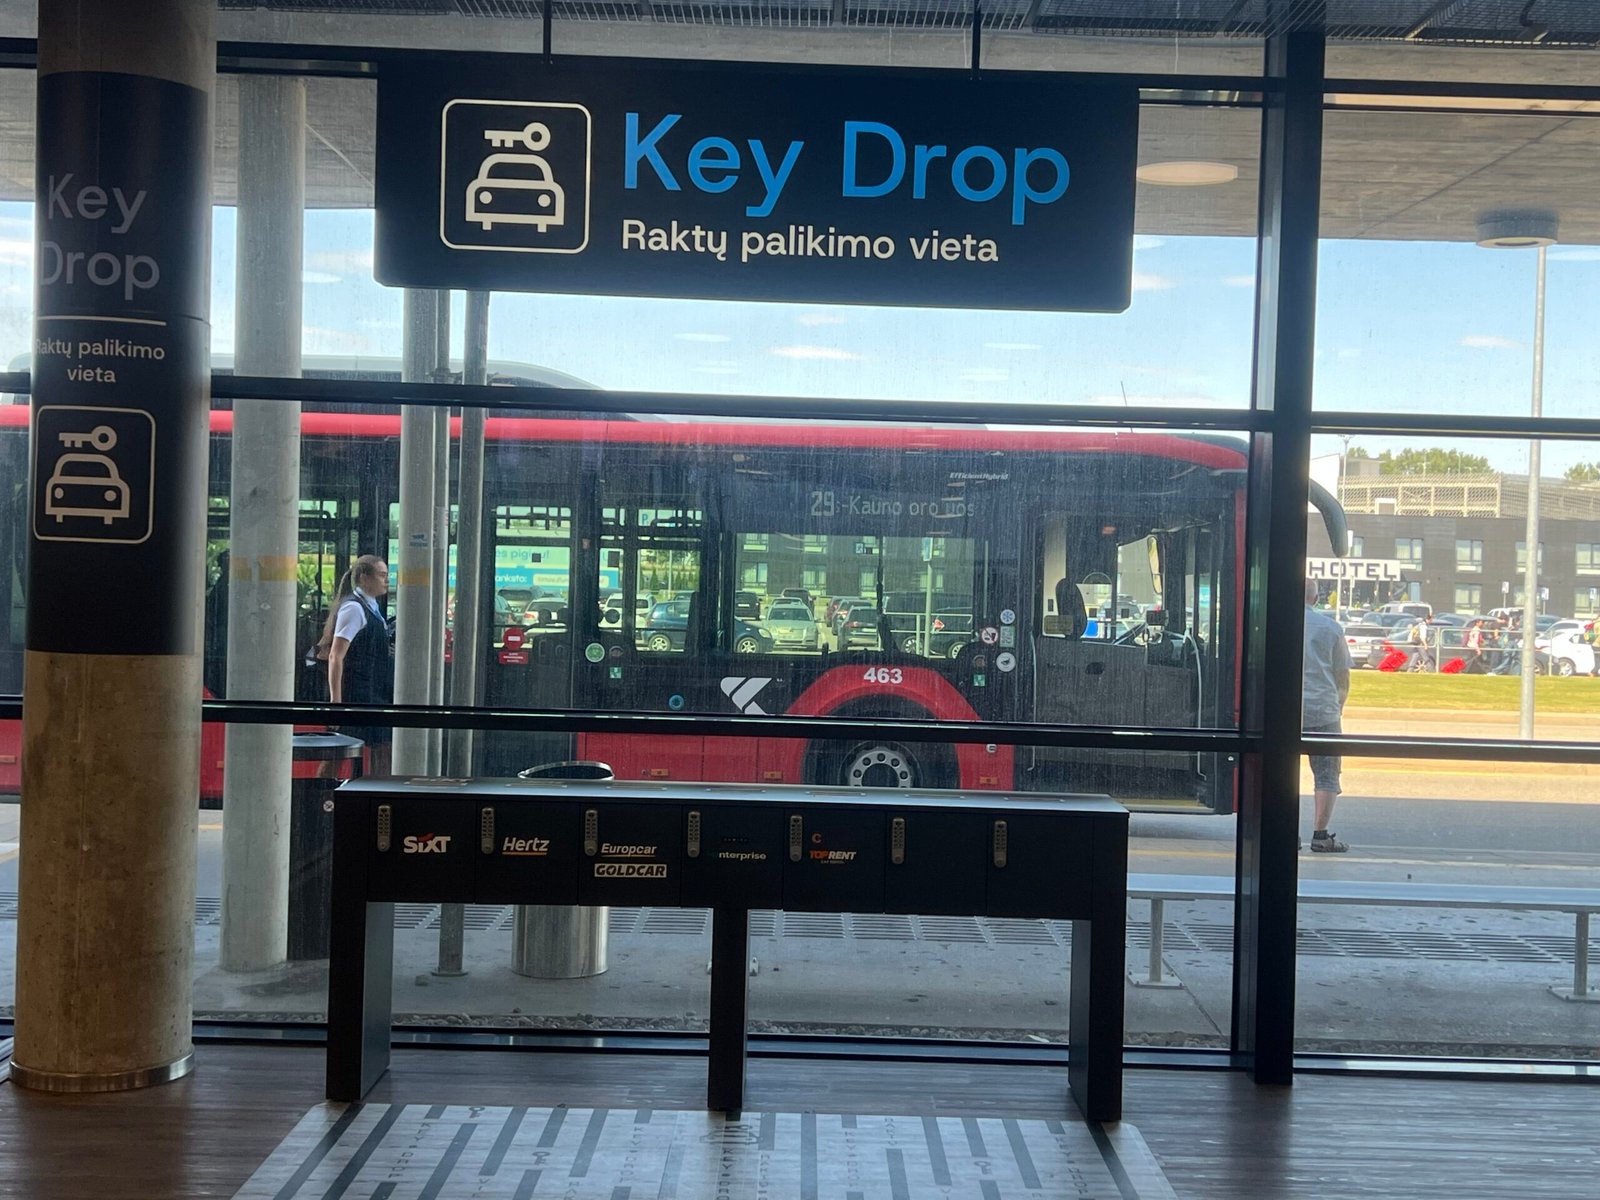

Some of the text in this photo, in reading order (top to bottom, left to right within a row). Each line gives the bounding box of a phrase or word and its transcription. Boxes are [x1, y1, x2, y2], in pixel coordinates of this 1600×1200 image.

[624, 112, 1071, 226] Key Drop
[48, 172, 147, 234] Key
[622, 219, 999, 264] Raktų palikimo vieta
[39, 241, 161, 301] Drop
[78, 338, 166, 361] palikimo
[67, 364, 116, 383] vieta
[810, 490, 835, 516] 29
[1309, 561, 1397, 579] HOTEL
[863, 667, 903, 684] 463
[502, 837, 550, 853] Hertz
[601, 843, 657, 856] Europcar
[708, 850, 768, 862] nterprise
[595, 864, 666, 877] GOLDCAR
